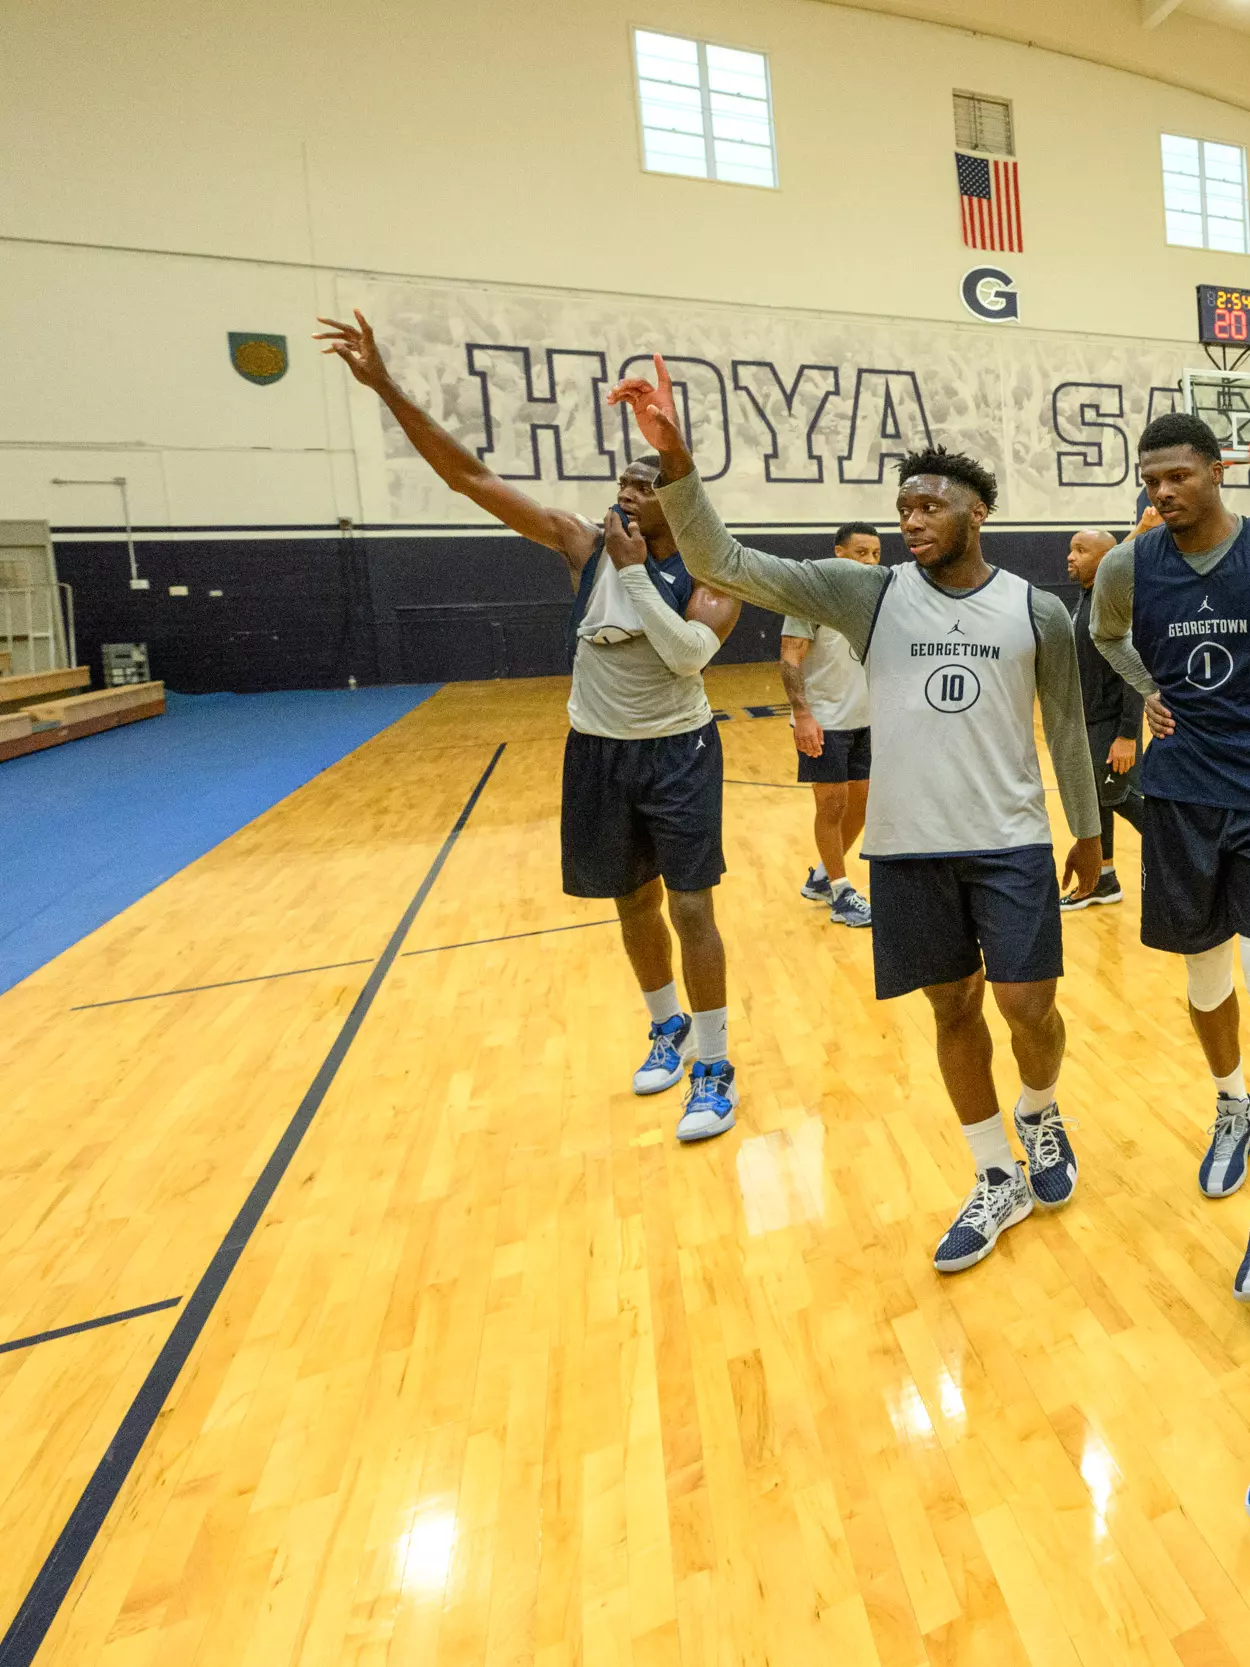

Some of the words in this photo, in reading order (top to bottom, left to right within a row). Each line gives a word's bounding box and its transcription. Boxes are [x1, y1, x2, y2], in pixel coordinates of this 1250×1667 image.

[960, 265, 1019, 322] G
[1214, 308, 1248, 340] 20
[465, 342, 936, 485] HOYA
[1168, 619, 1248, 637] GEORGETOWN
[910, 642, 1000, 660] GEORGETOWN
[1203, 652, 1211, 679] 1
[941, 674, 964, 701] 10
